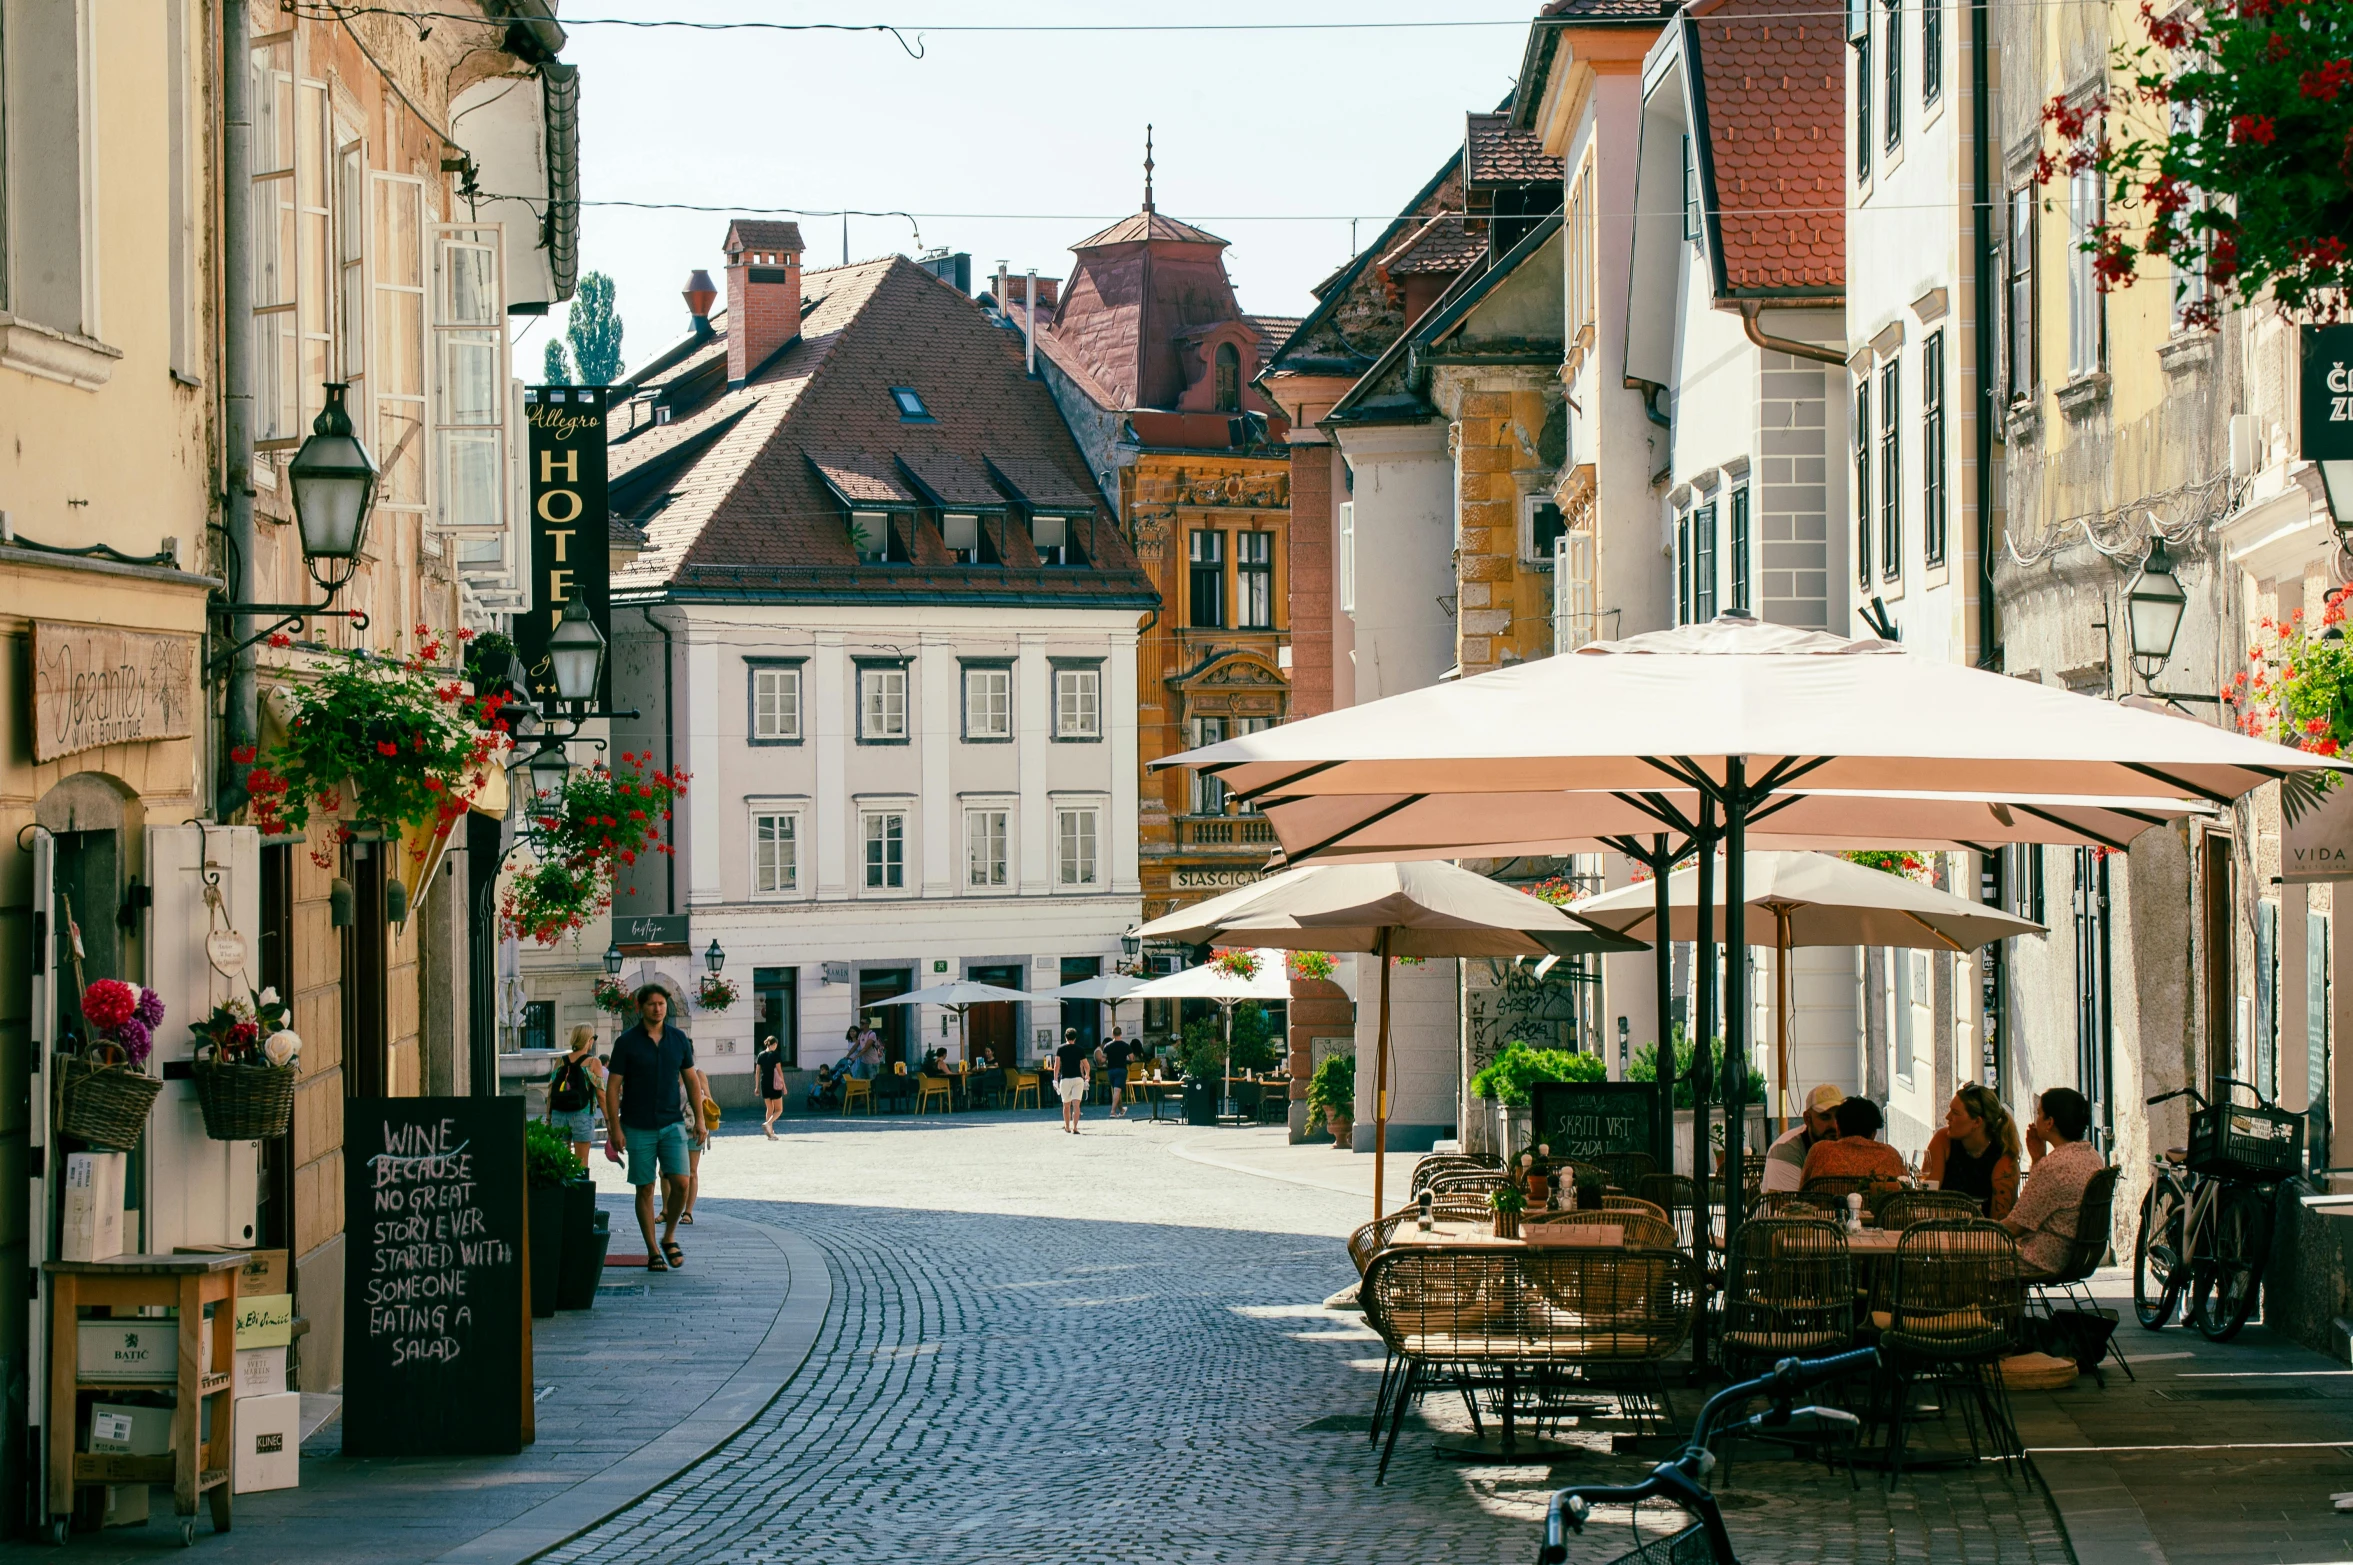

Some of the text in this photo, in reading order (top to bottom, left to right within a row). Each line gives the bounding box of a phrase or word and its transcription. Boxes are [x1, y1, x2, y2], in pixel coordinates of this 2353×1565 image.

[525, 403, 600, 440] Allegro
[39, 639, 147, 744] Dekanter
[71, 719, 142, 748] WINE BOUTIQUE
[2293, 847, 2346, 861] VIDA
[826, 967, 848, 977] KAMEN
[384, 1118, 455, 1155] WINE
[1558, 1115, 1634, 1138] SKRITI VRT
[371, 1154, 473, 1188] BECAUSE
[375, 1182, 477, 1216] NO GREAT
[373, 1206, 487, 1245] STORY EVER
[371, 1239, 513, 1272] STARTED WITH
[364, 1269, 468, 1305] SOMEONE
[370, 1304, 472, 1337] EATING A
[247, 1360, 267, 1368] SVETI
[391, 1336, 460, 1367] SALAD
[243, 1367, 270, 1376] MARTIN
[257, 1435, 282, 1448] KLINEC
